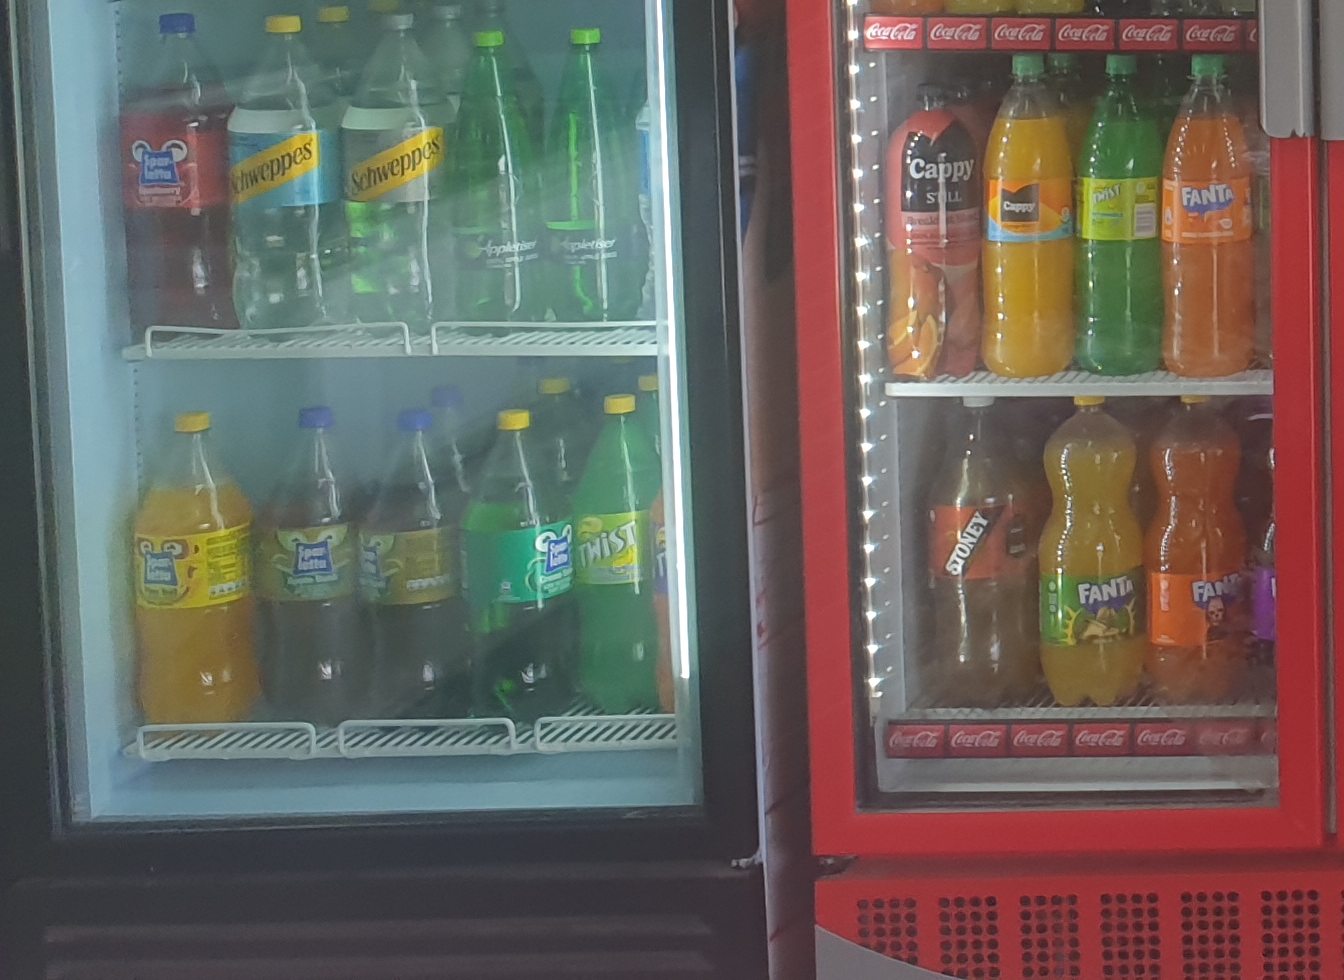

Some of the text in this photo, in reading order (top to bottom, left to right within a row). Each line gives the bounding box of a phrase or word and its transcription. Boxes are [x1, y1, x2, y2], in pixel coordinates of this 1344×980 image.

[866, 22, 919, 41] Coca-Cola
[930, 23, 983, 41] Coca-Cola
[994, 24, 1047, 42] Coca-Cola
[1058, 24, 1109, 42] Coca-Cola
[1121, 24, 1173, 42] Coca-Cola
[1185, 24, 1236, 42] Coca-Cola
[351, 135, 440, 195] Schweppes
[910, 158, 975, 183] Cappy
[1181, 184, 1234, 207] FANTA
[1003, 201, 1036, 213] Cappy
[945, 511, 989, 576] STONEY
[1077, 576, 1134, 605] FANTA
[950, 730, 1001, 748] Coca-Cola
[1012, 729, 1065, 748] Coca-Cola
[1075, 729, 1125, 747] Coca-Cola
[1136, 728, 1188, 747] Coca-Cola
